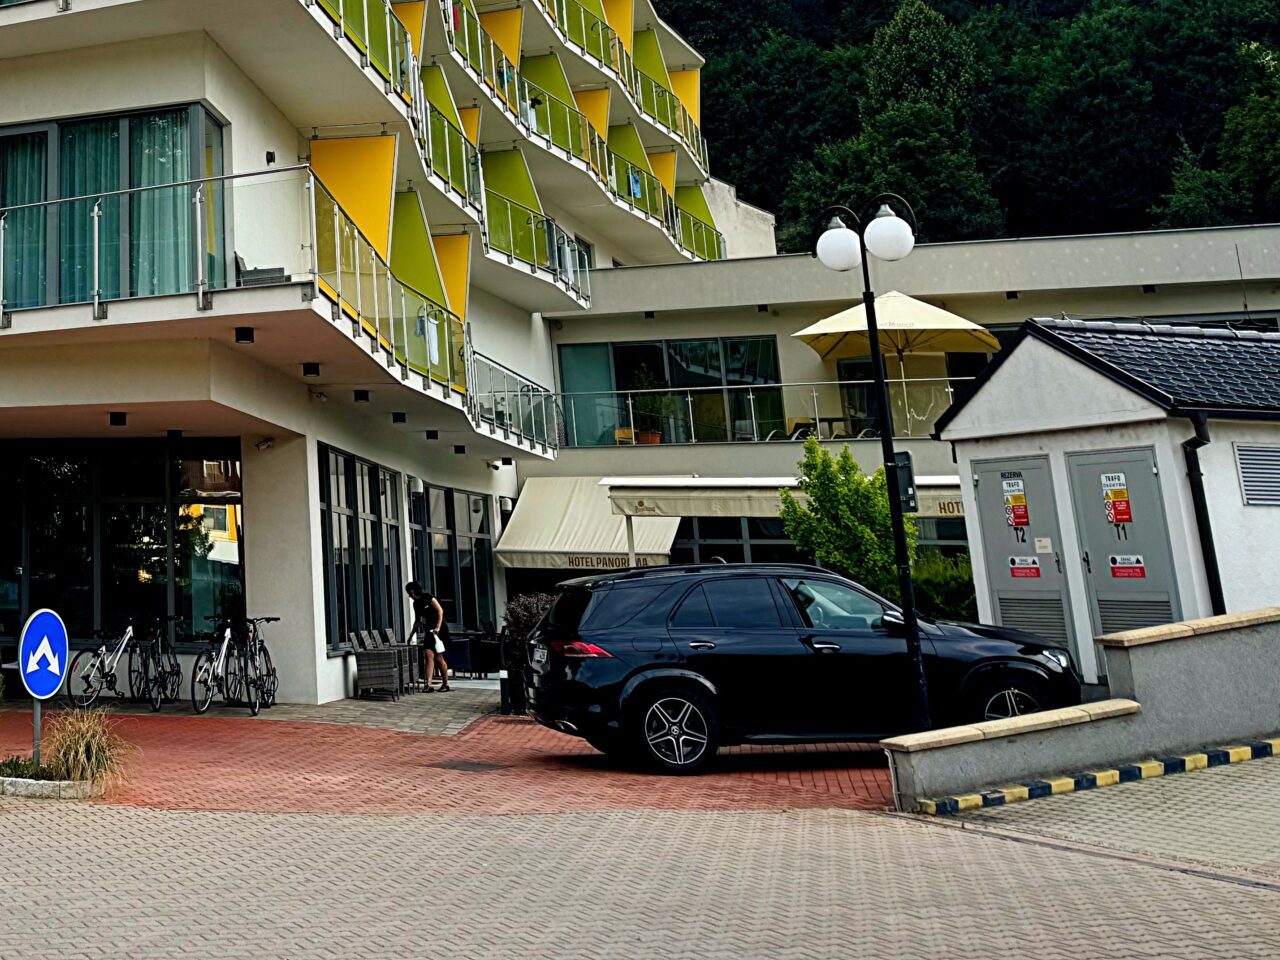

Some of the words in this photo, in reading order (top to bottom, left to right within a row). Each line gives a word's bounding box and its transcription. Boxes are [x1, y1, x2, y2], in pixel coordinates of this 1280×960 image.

[1013, 526, 1027, 543] T2
[1114, 523, 1128, 541] T1
[568, 556, 596, 567] HOTEL
